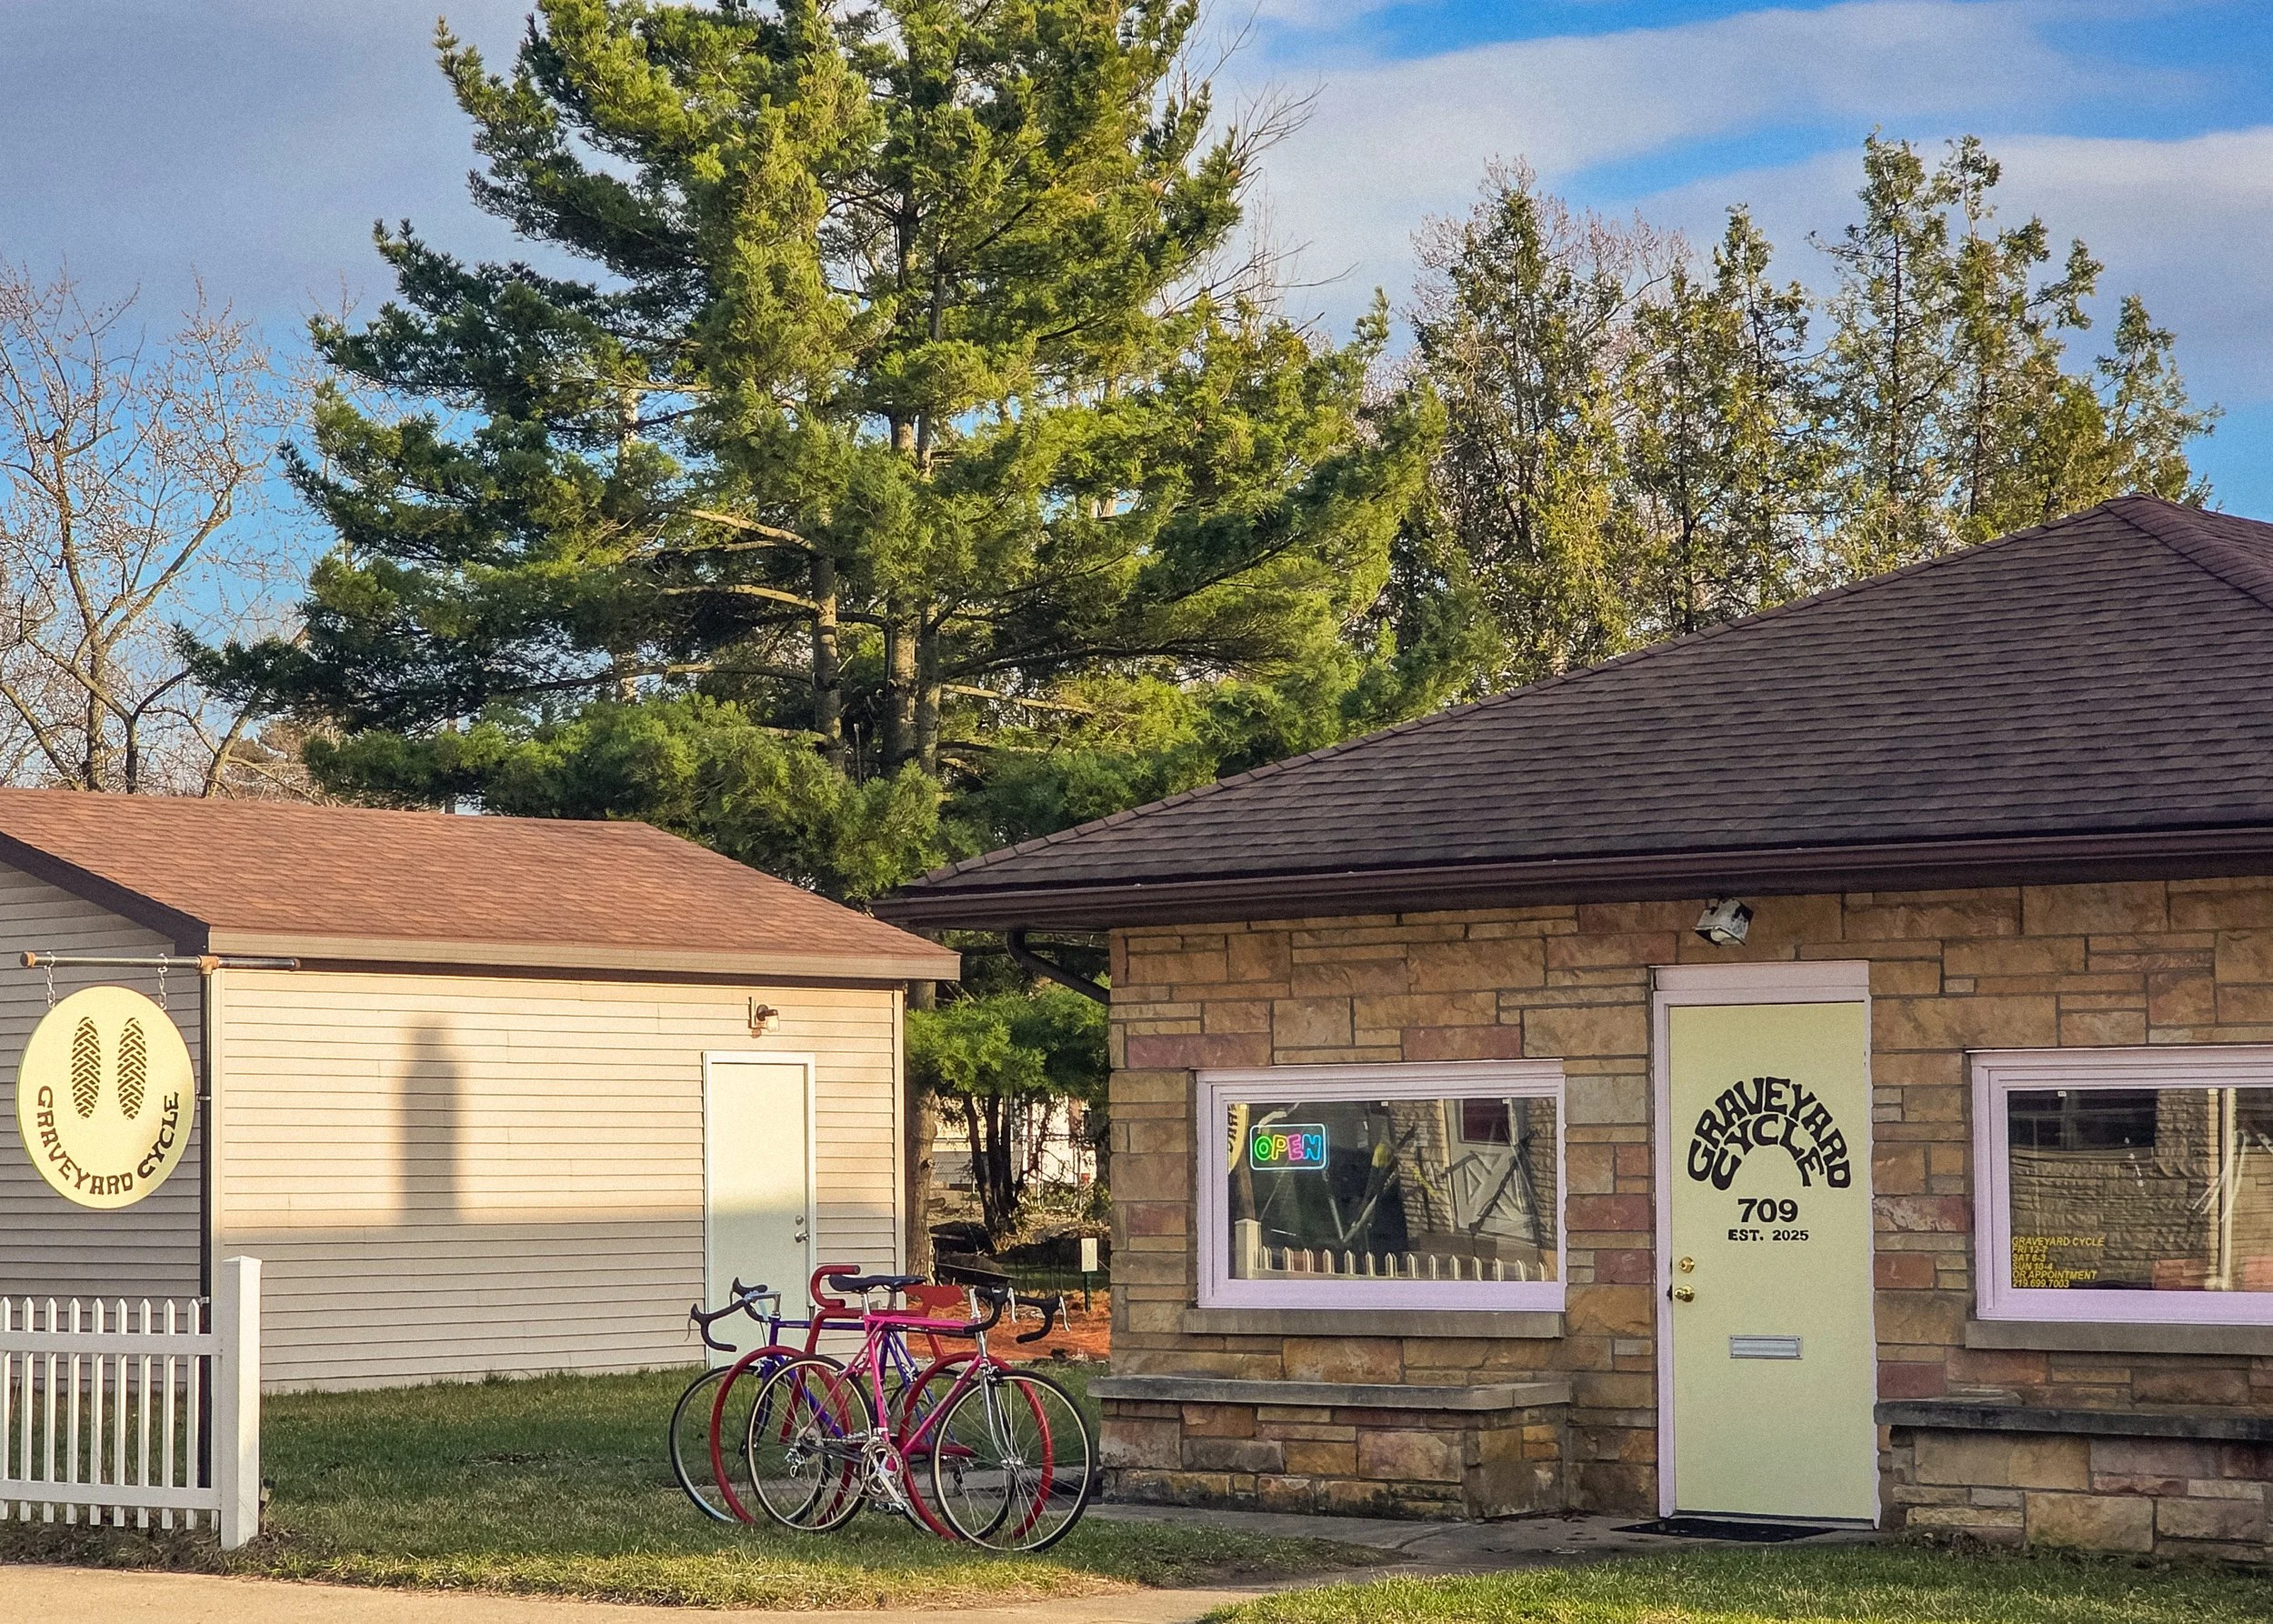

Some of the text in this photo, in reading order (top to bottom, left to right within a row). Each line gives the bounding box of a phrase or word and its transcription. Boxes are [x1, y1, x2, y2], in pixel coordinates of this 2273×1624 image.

[1687, 1077, 1851, 1188] GRAVEYARD
[37, 1085, 180, 1196] GRAVEYARD CYCLE
[1255, 1133, 1322, 1161] OPEN
[1711, 1114, 1825, 1190] CYCLE
[1737, 1198, 1798, 1223] 709
[1727, 1229, 1809, 1241] EST. 2025
[2012, 1237, 2105, 1247] GRAVEYARD CYCLE
[2011, 1245, 2028, 1254] FRI
[2012, 1253, 2030, 1262] SAT
[2012, 1262, 2053, 1270] SUN 10-4
[2012, 1270, 2098, 1280] OR APPOINTMENT
[2012, 1278, 2070, 1288] 219.699.7003
